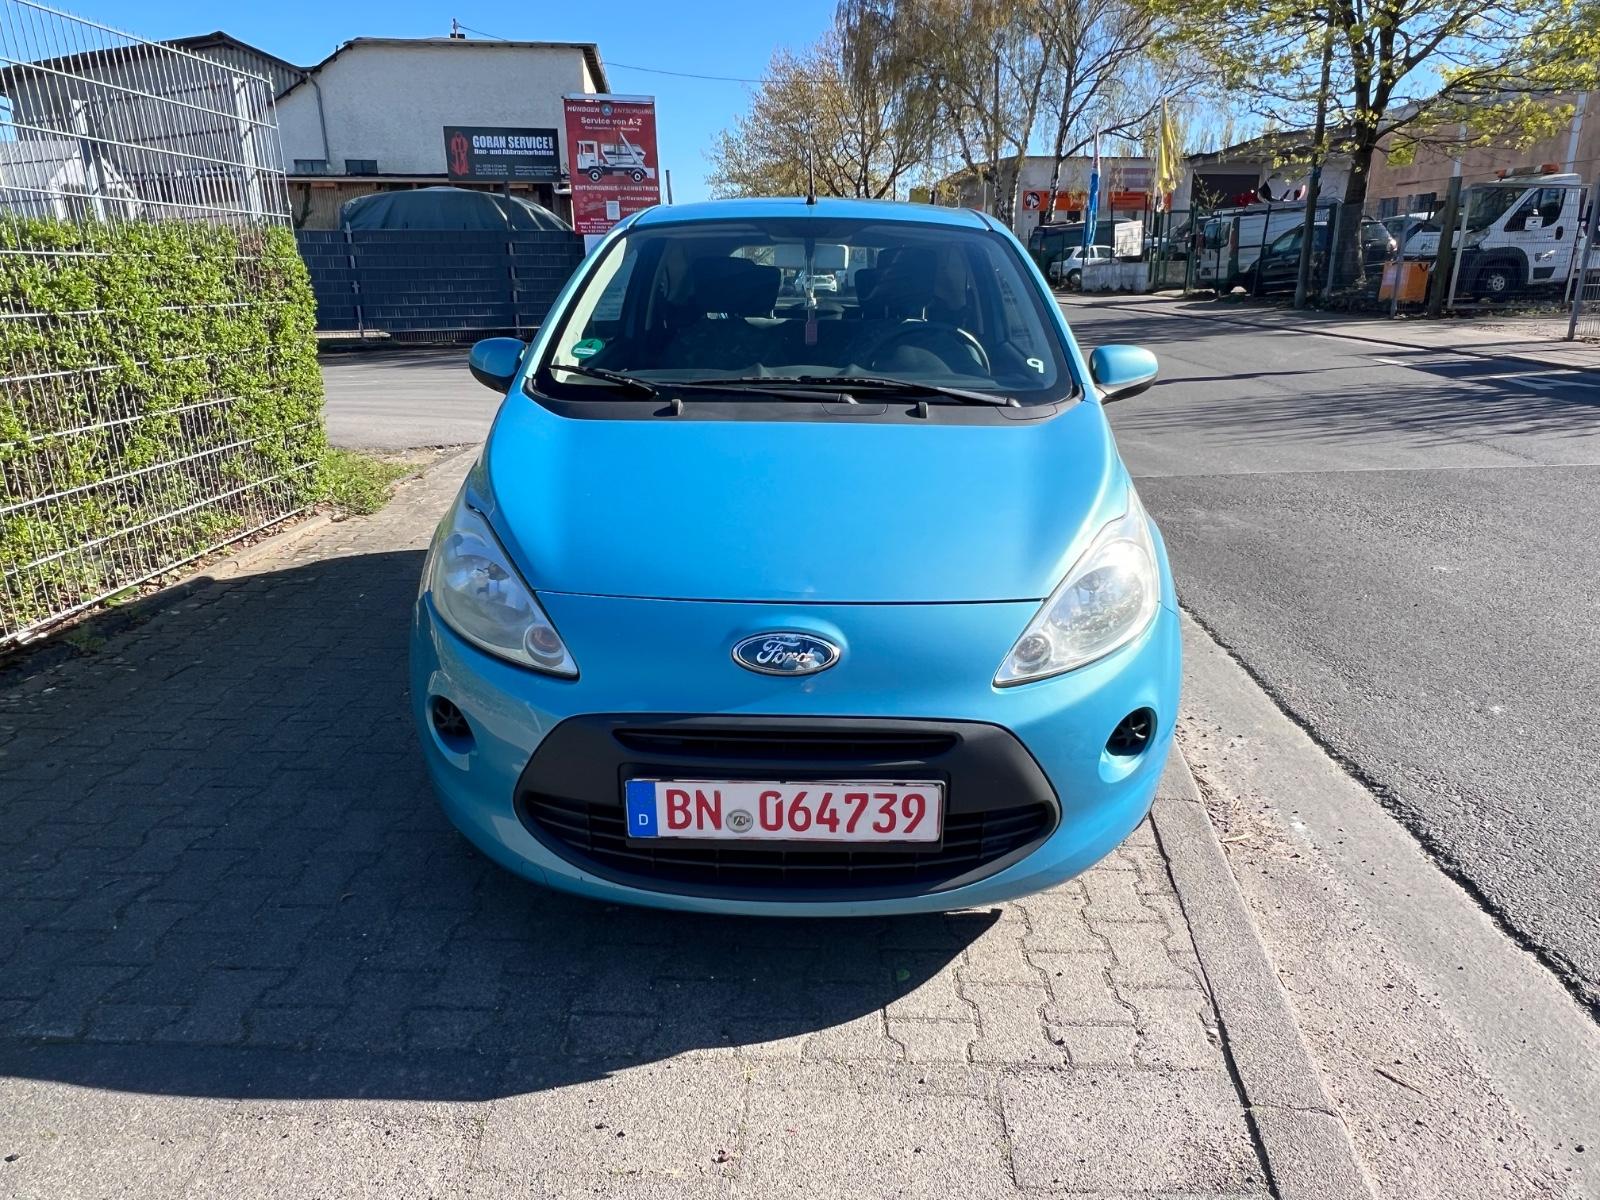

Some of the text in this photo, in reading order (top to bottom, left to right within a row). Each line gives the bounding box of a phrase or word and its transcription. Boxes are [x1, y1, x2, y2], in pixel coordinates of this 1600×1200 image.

[628, 118, 642, 126] A-Z
[472, 135, 506, 148] GORAN
[507, 136, 549, 149] SERVICE
[756, 640, 815, 664] Ford
[638, 788, 927, 833] D BN 064739
